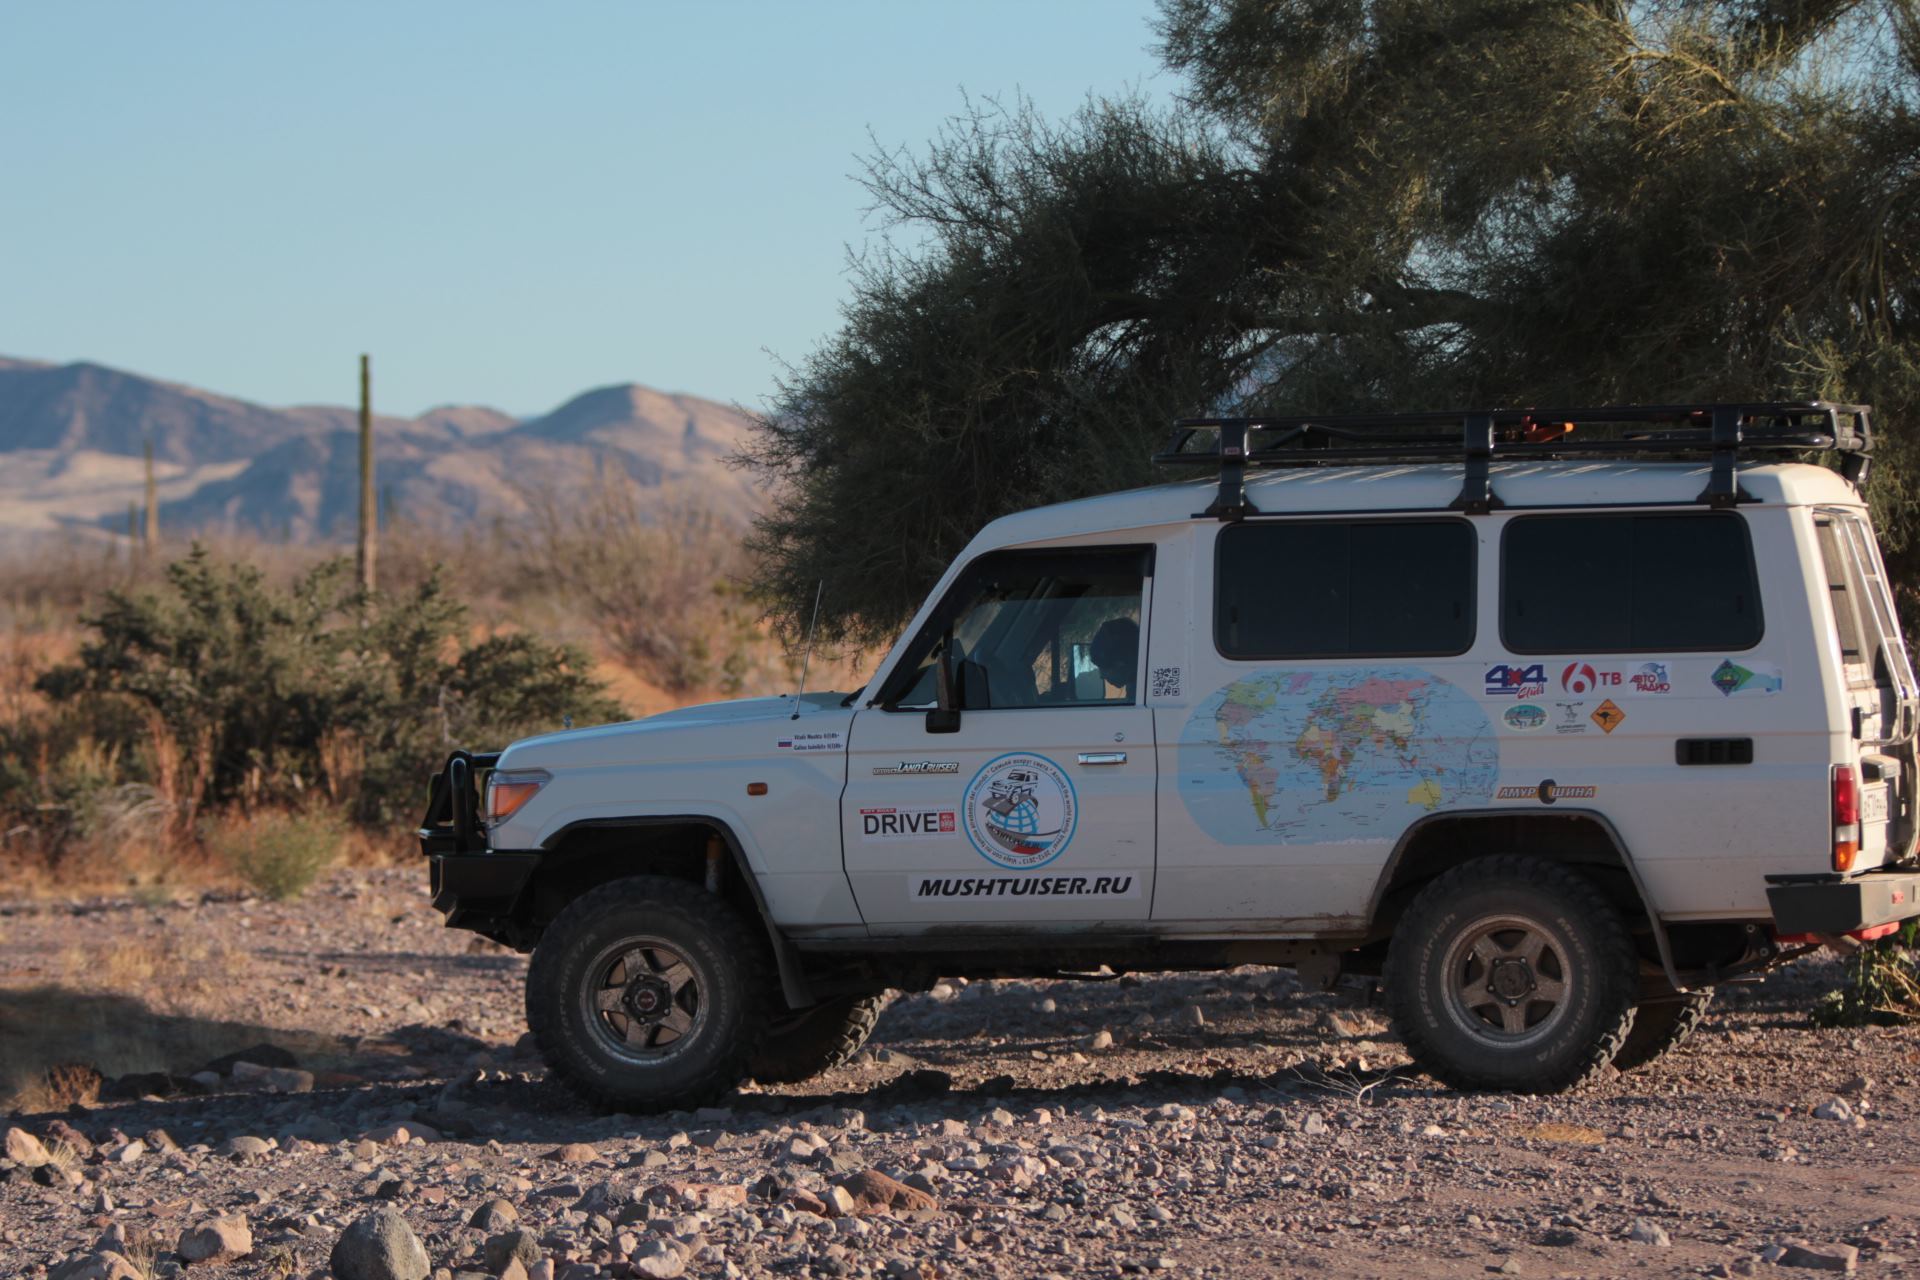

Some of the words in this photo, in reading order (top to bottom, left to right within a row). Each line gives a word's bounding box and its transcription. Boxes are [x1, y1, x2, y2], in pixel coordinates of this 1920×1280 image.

[1629, 673, 1657, 684] АВТО
[1636, 681, 1671, 692] РАДИО
[1499, 787, 1536, 798] АМУР
[1552, 787, 1594, 798] ШИНА
[864, 813, 938, 834] DRIVE
[918, 876, 1132, 897] MUSHTUISER.RU
[1418, 913, 1456, 1028] BFGoodrich
